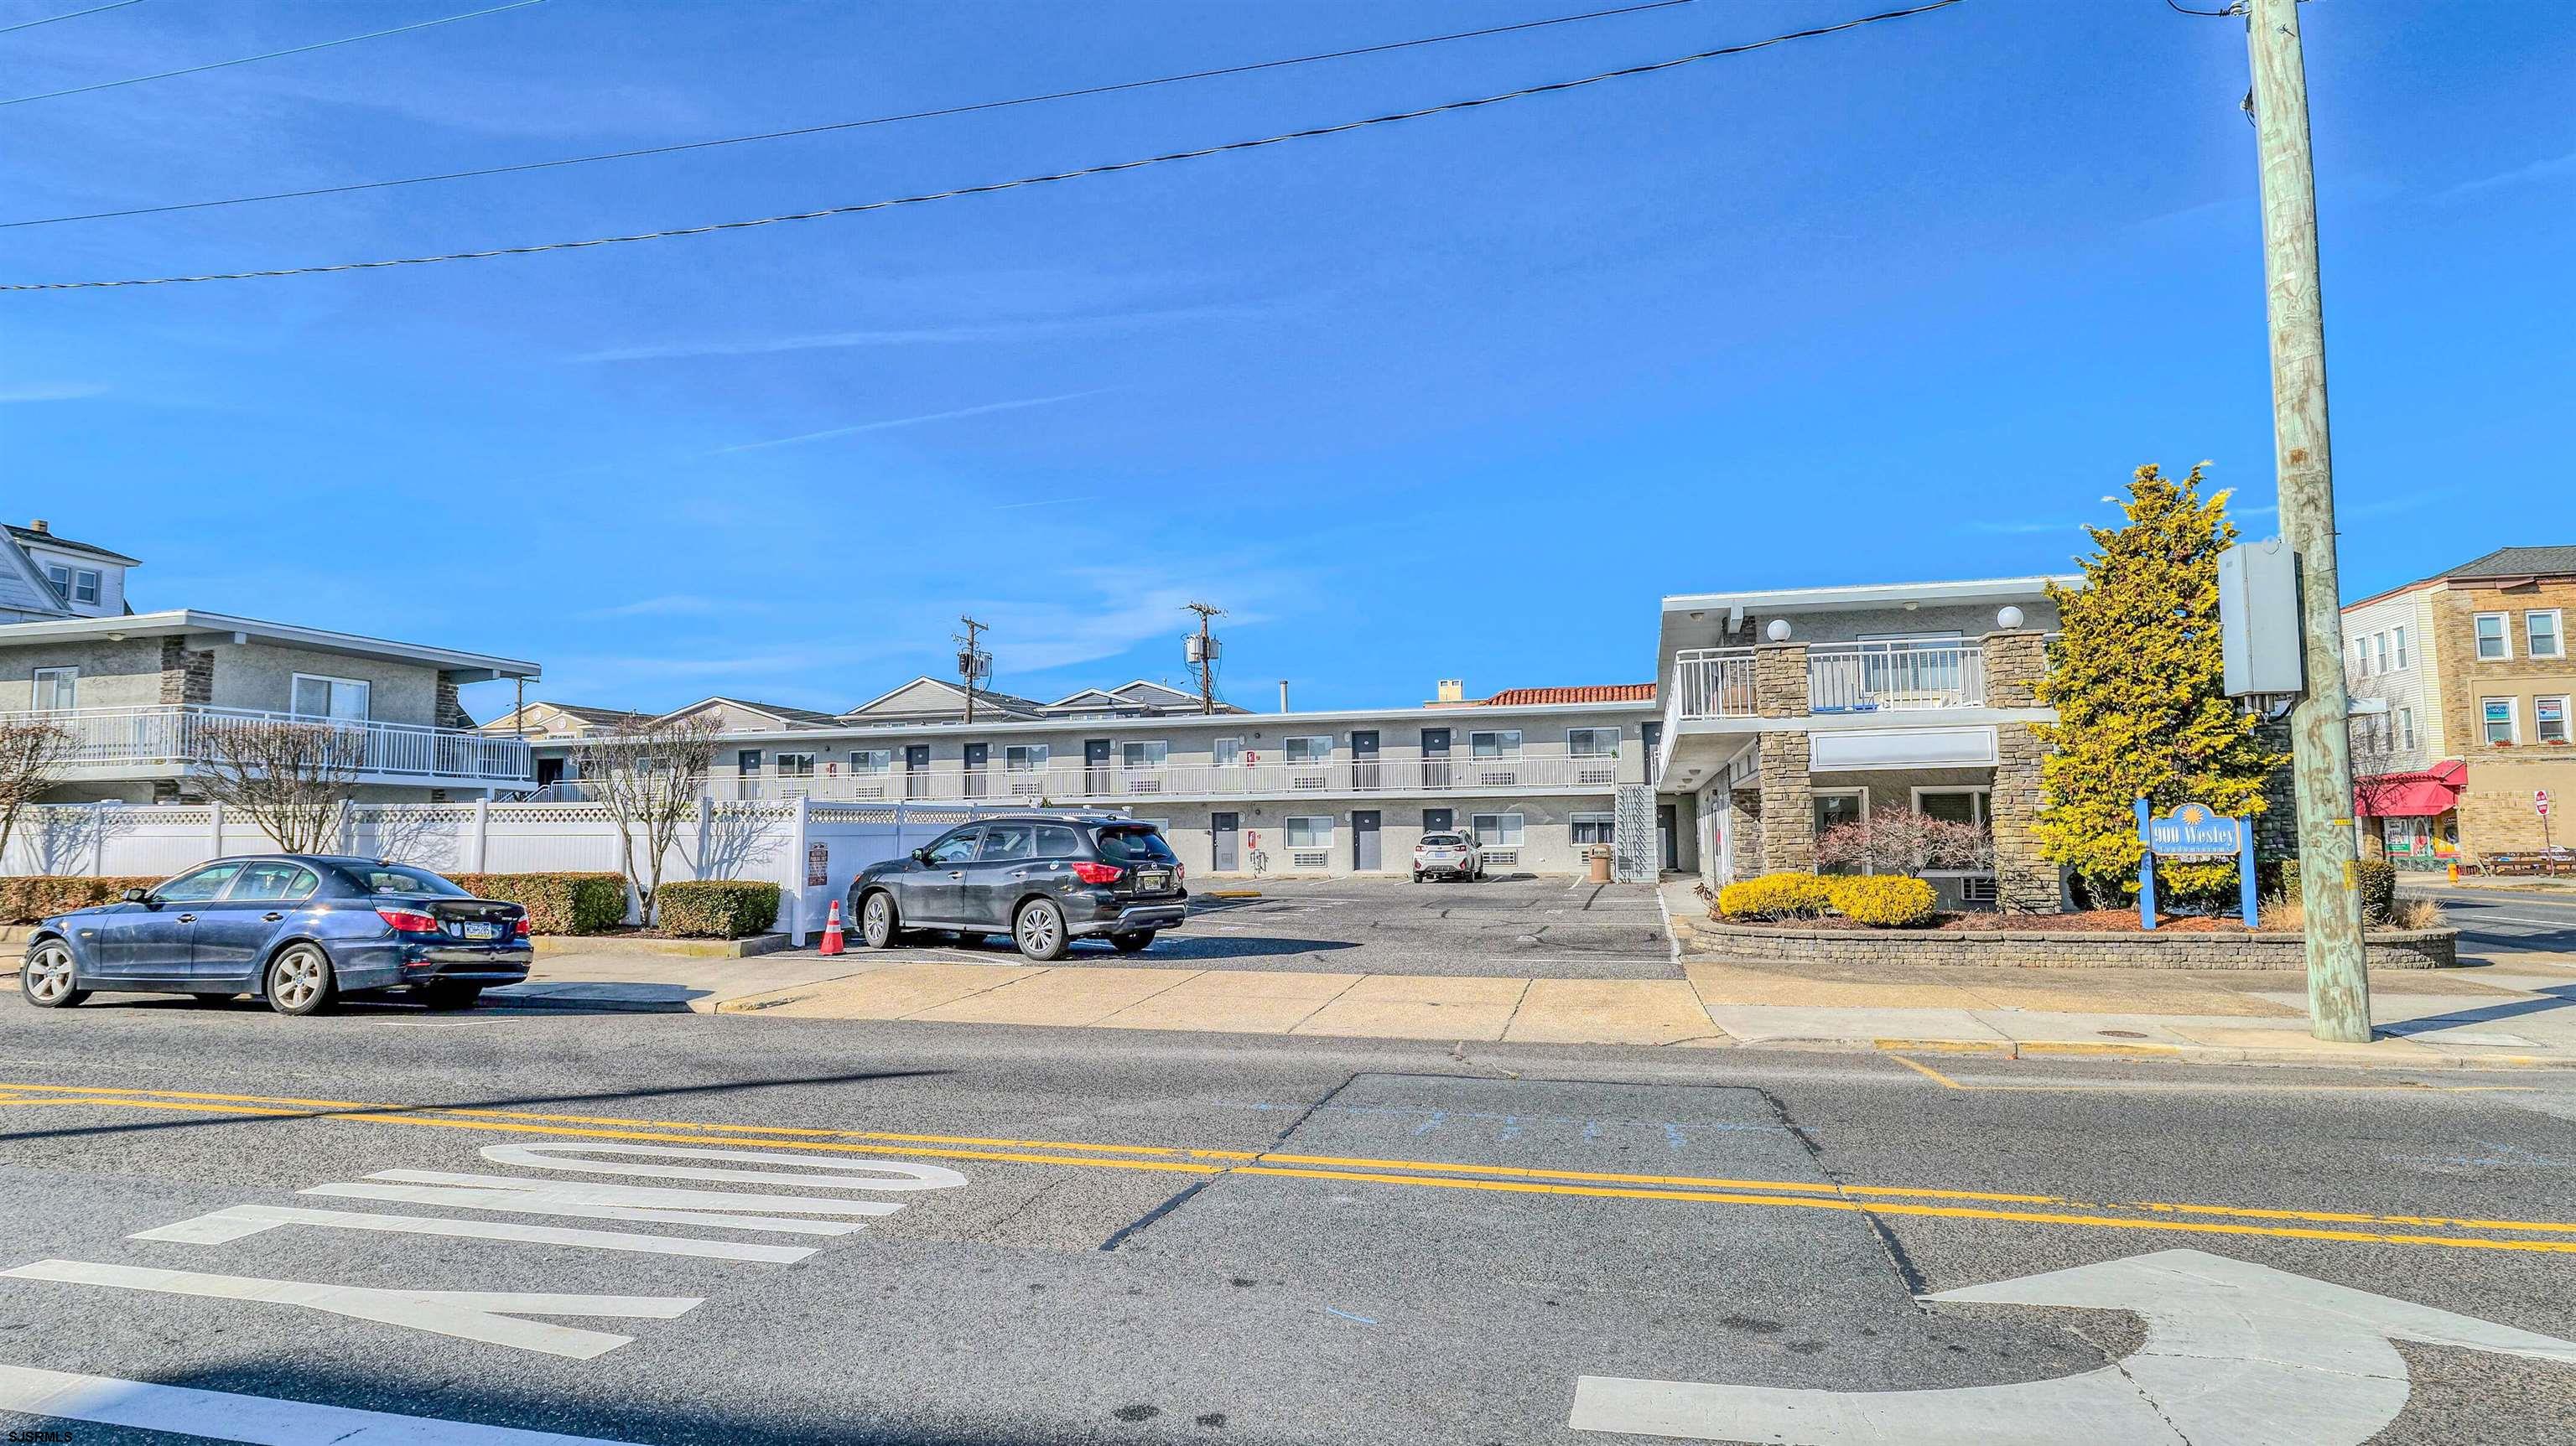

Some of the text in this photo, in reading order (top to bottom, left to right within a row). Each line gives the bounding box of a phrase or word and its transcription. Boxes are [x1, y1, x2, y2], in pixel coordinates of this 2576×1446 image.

[2154, 826, 2235, 846] 900 Wesley
[0, 1143, 969, 1360] ONLY
